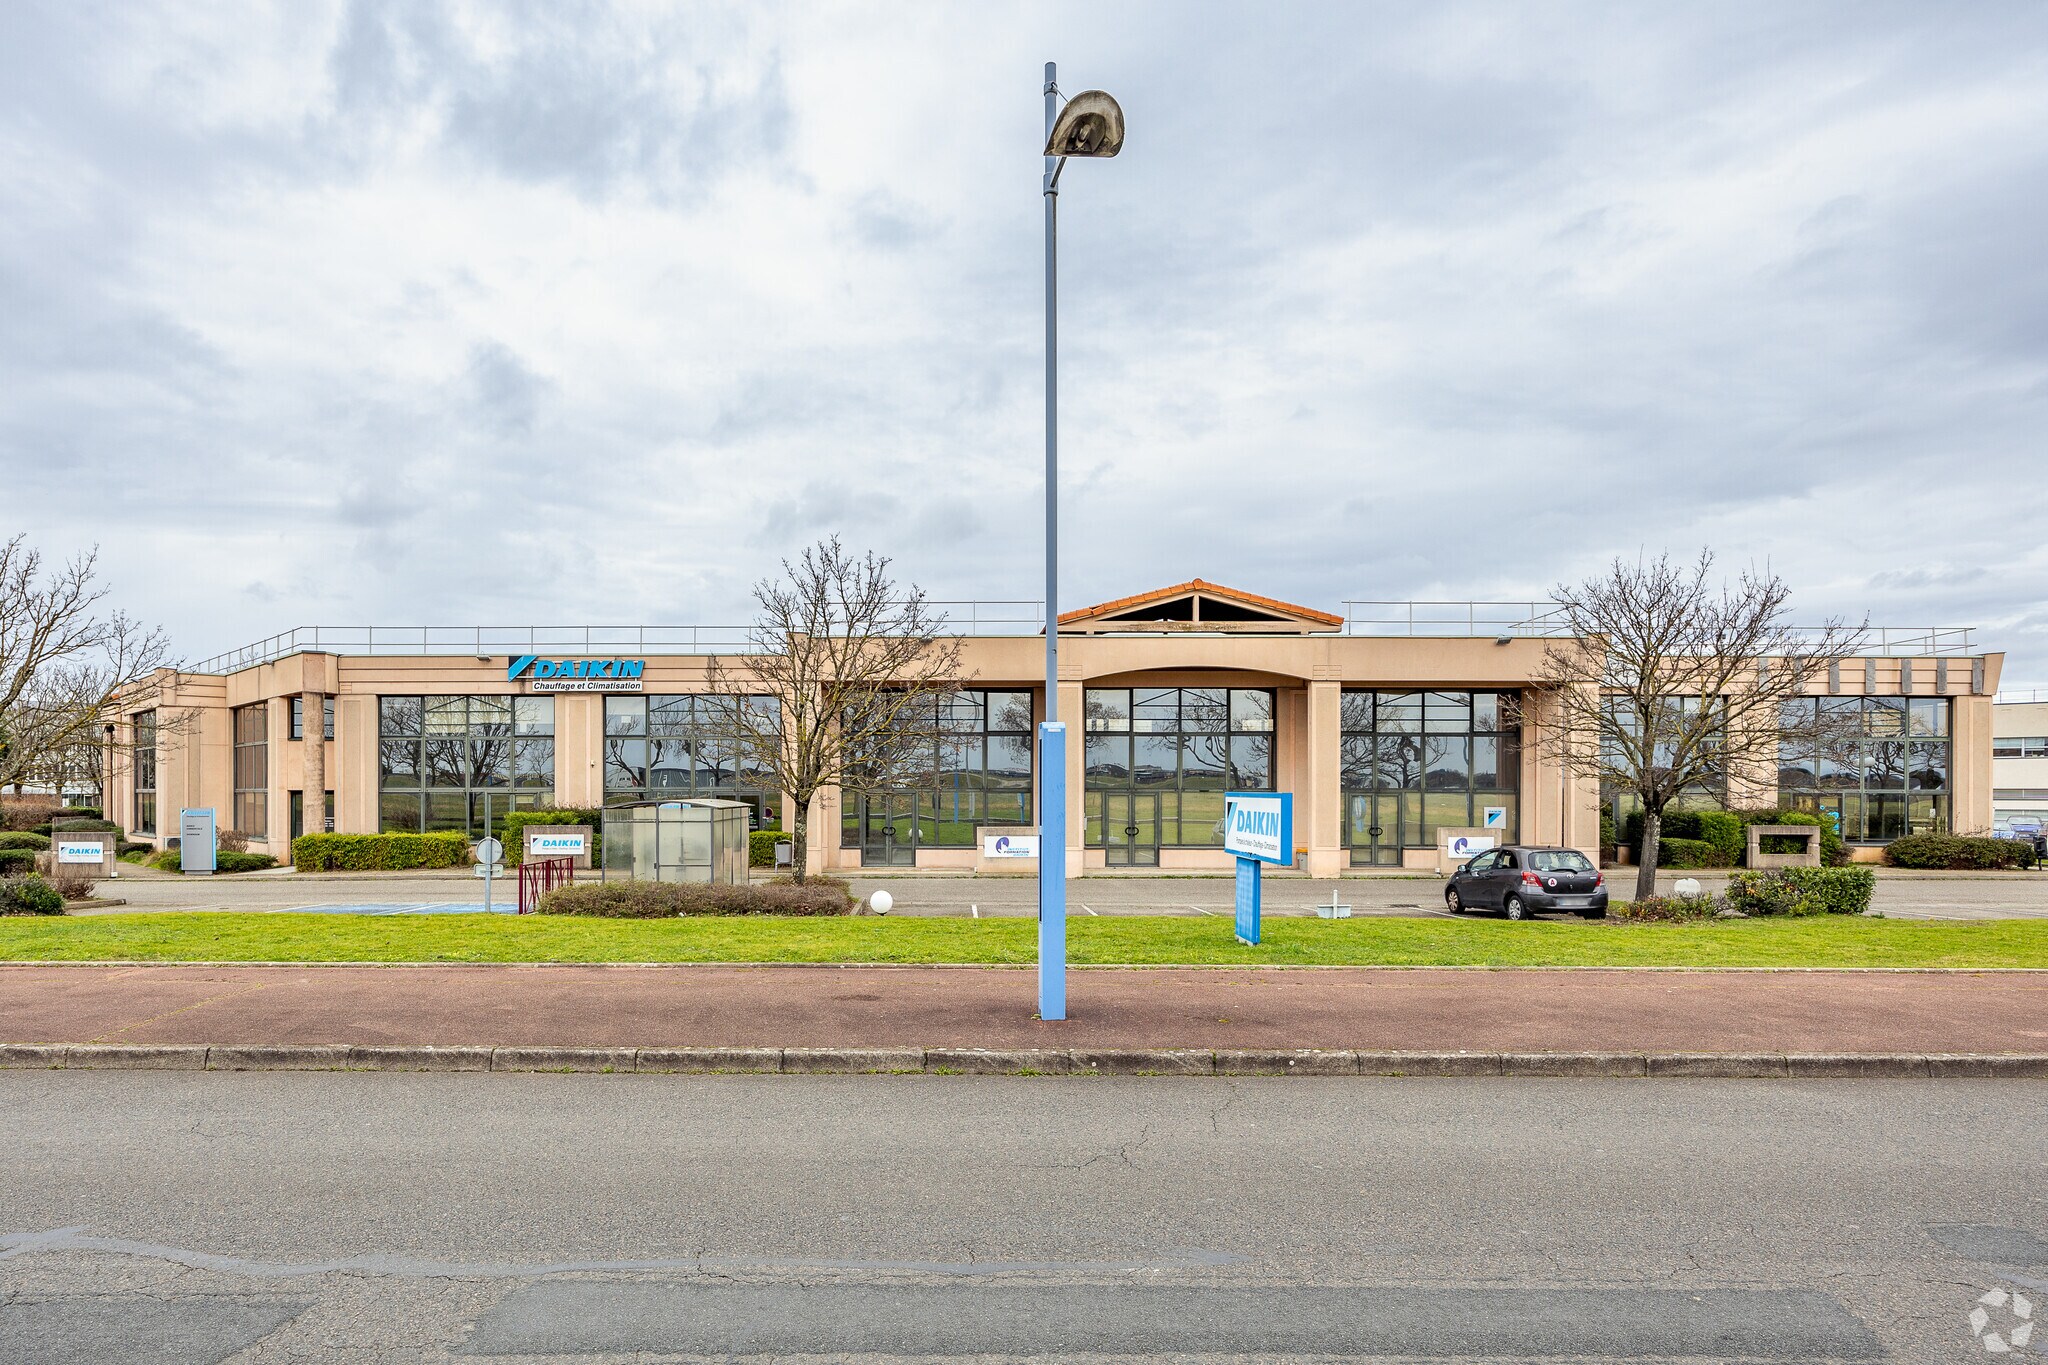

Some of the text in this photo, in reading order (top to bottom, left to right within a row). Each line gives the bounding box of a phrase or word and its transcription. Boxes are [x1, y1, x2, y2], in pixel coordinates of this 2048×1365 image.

[534, 660, 645, 678] DAIKIN
[534, 682, 575, 691] Chauffage
[587, 682, 641, 690] Climatisation
[1237, 810, 1279, 837] DAIKIN
